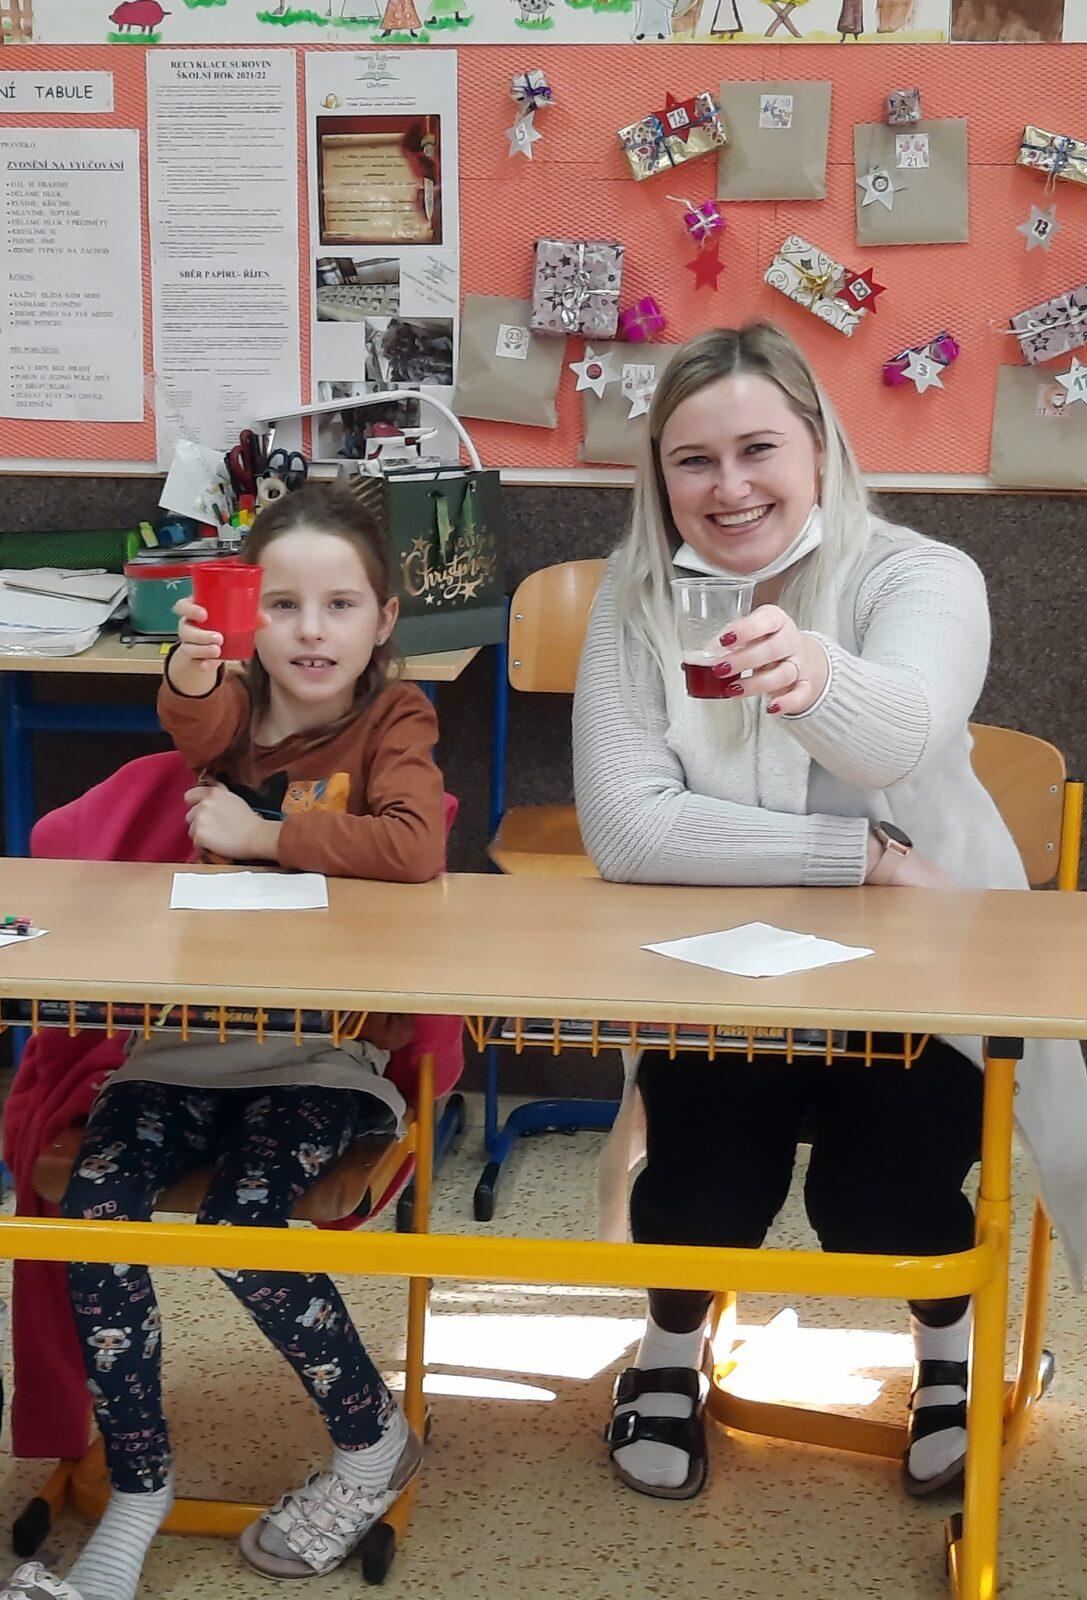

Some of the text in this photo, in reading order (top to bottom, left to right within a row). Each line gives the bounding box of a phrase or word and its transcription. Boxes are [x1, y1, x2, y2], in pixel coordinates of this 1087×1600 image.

[170, 61, 272, 69] RECYKLACE SUROVIN
[176, 69, 266, 79] ŠKOLNÍ ROK 2021/22
[34, 85, 93, 99] TABULE
[906, 156, 918, 167] 21
[1035, 219, 1048, 235] 13
[179, 269, 203, 278] SBĚR
[243, 268, 270, 278] ŘÍJEN
[853, 282, 868, 297] 8
[917, 363, 928, 376] 3
